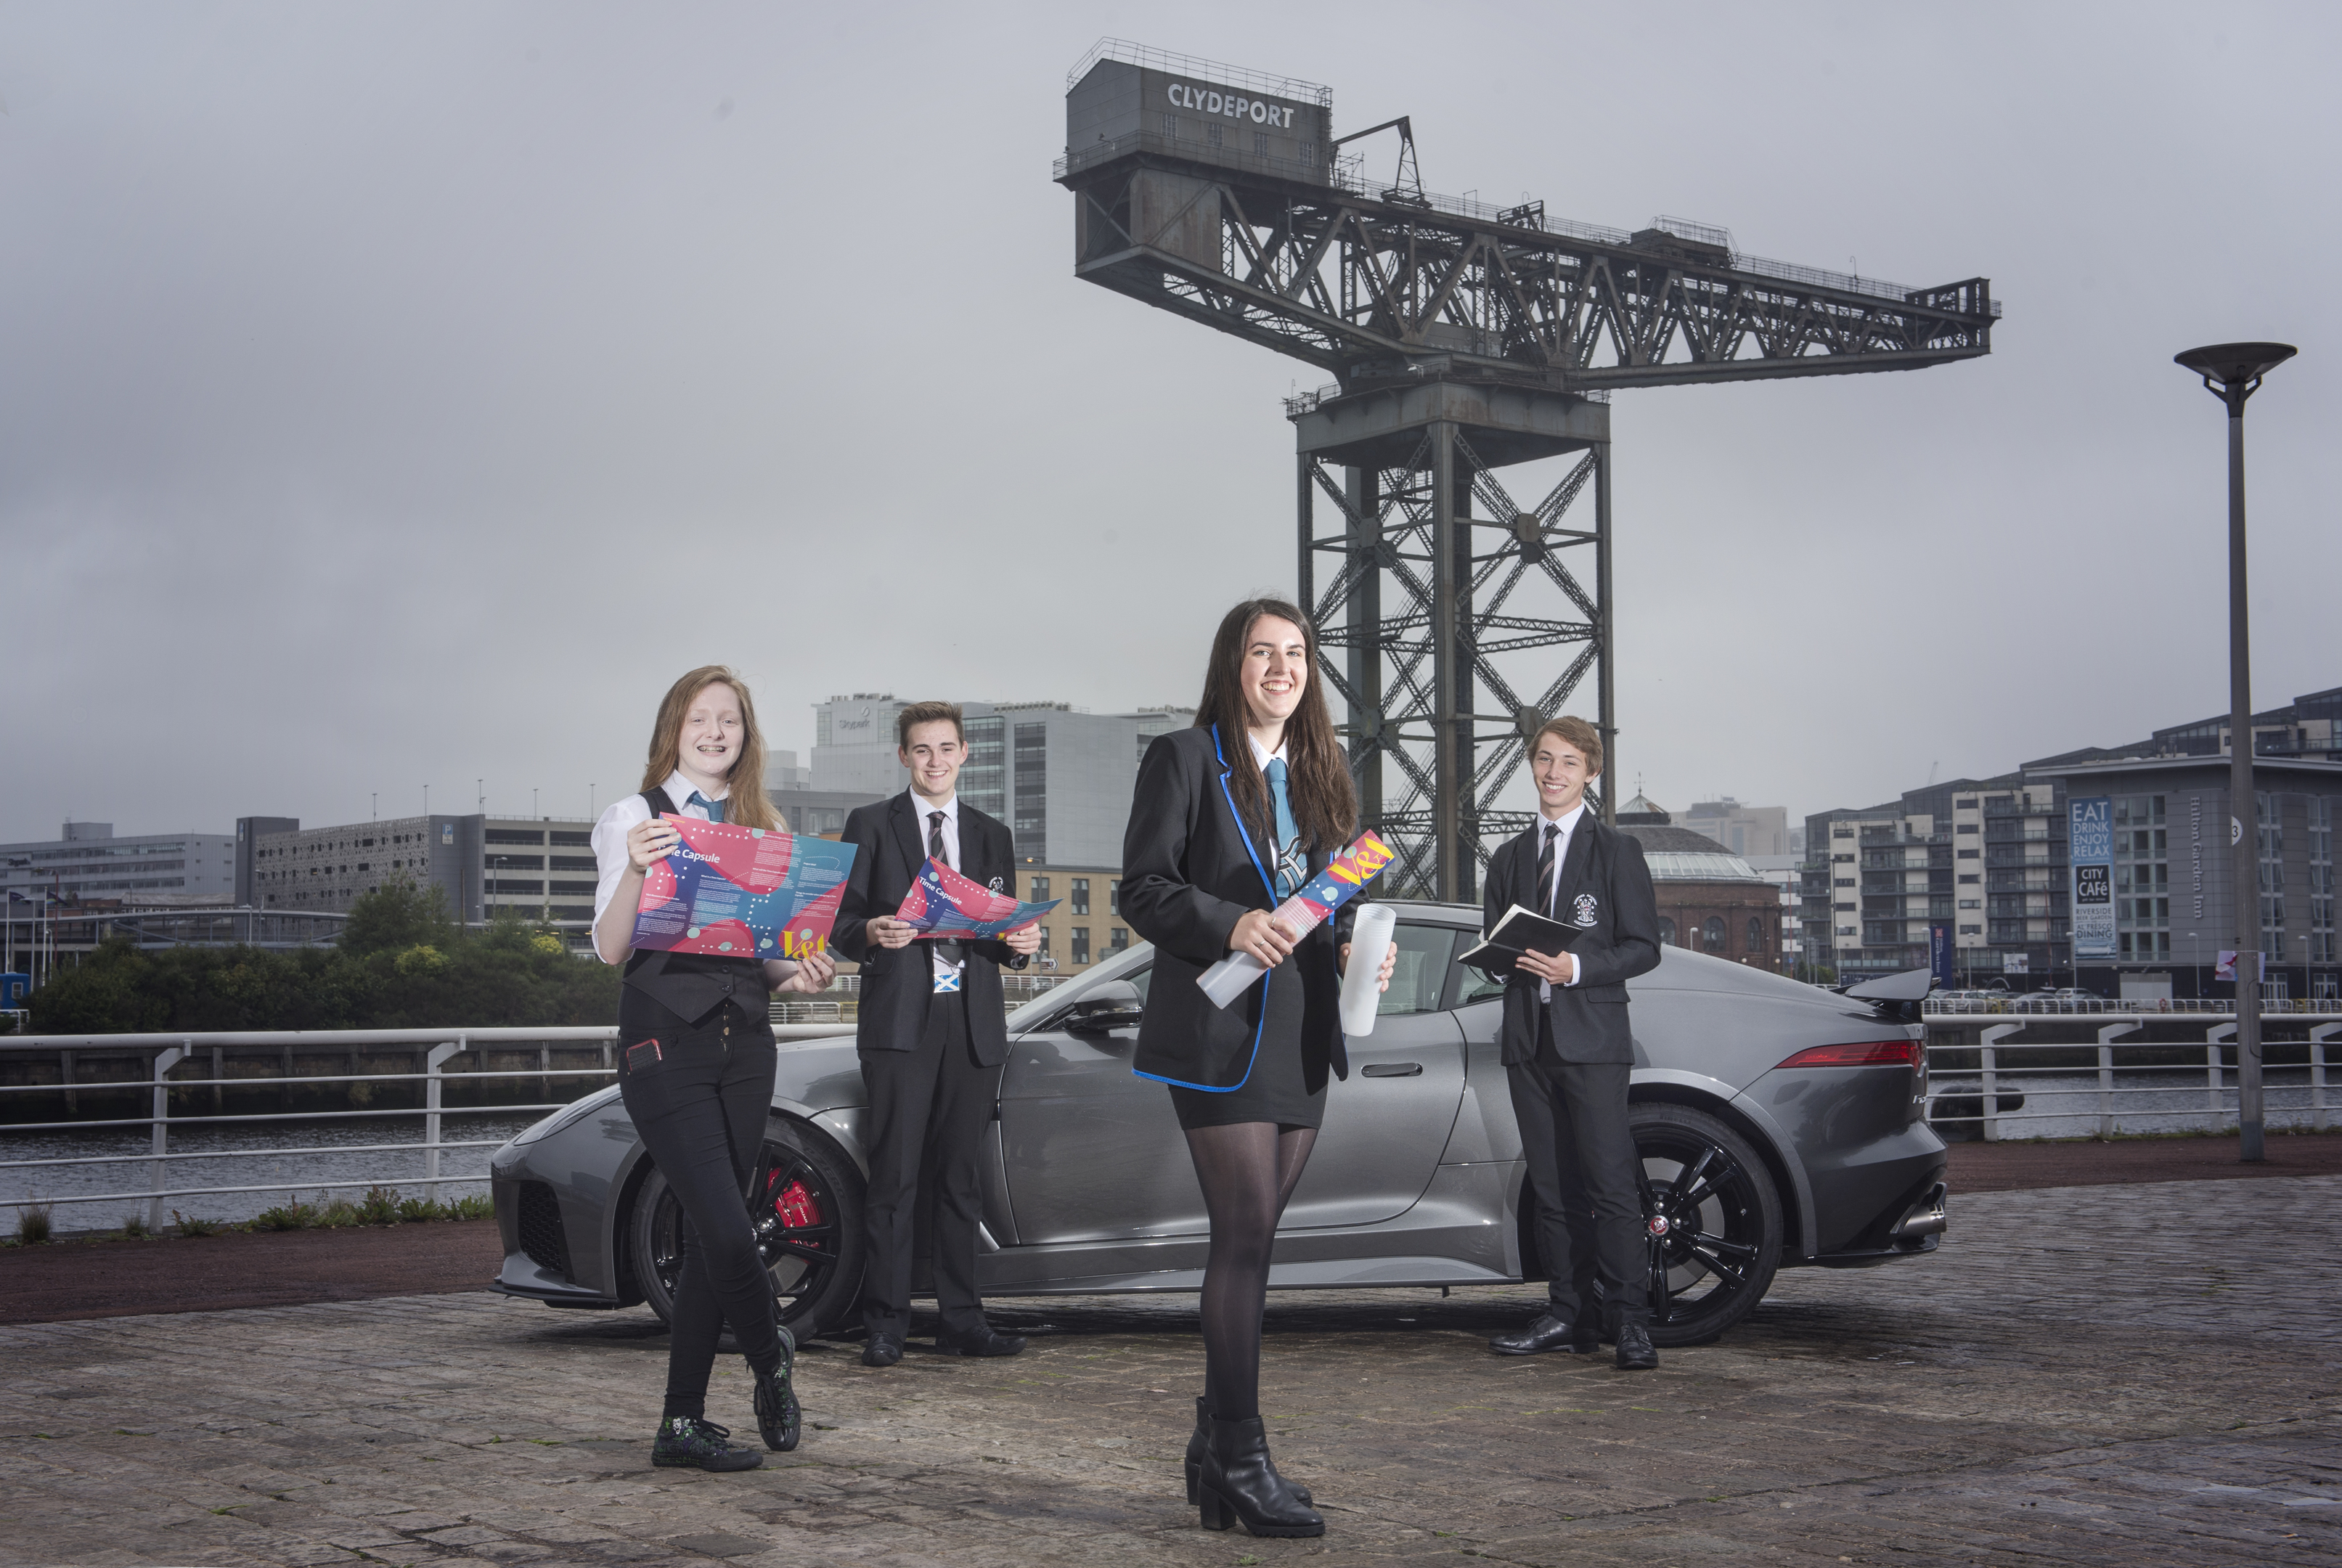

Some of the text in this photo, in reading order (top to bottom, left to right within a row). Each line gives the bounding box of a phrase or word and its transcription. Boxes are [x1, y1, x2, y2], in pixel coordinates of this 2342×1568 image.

[1167, 83, 1294, 128] CLYDEPORT
[839, 719, 870, 730] Skypark
[2073, 801, 2108, 822] EAT
[444, 825, 452, 834] P
[2073, 821, 2109, 834] DRINK
[2073, 833, 2109, 846] ENJOY
[682, 849, 720, 863] Capsule
[2073, 844, 2110, 857] RELAX
[2191, 797, 2204, 919] Hilton Garden Inn
[1326, 837, 1395, 886] V&A
[2081, 868, 2103, 879] CITY
[919, 876, 962, 905] Time Capsule
[2078, 881, 2108, 897] CAFé
[2076, 930, 2113, 939] DINING
[782, 931, 825, 961] V&A
[796, 1201, 808, 1223] JAGUAR
